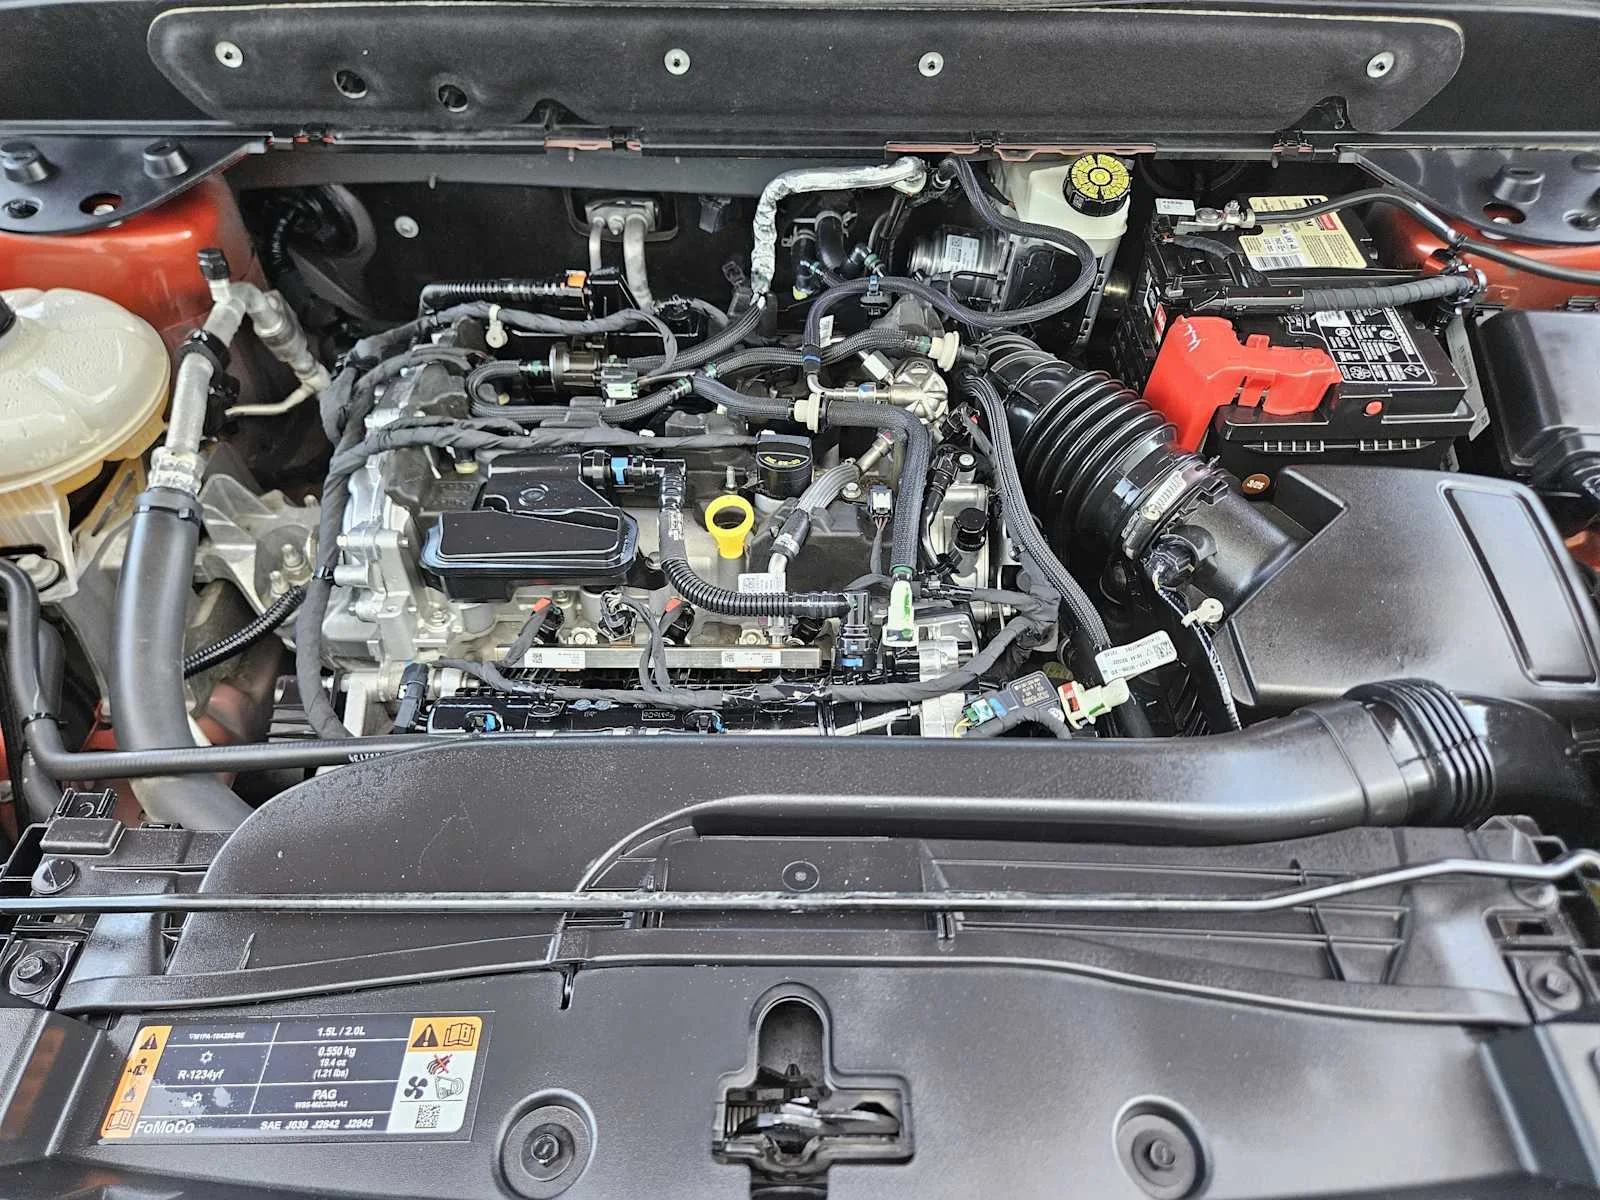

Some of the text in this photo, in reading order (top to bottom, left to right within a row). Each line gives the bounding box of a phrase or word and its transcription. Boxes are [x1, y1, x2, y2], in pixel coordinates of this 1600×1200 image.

[317, 1026, 337, 1036] 1.5L
[344, 1026, 366, 1036] 2.0L
[318, 1045, 357, 1058] 0.550 kg
[336, 1059, 347, 1067] oz
[177, 1069, 225, 1081] R-1234yf
[313, 1067, 349, 1080] (1.21 lbs)
[312, 1089, 337, 1100] PAG
[134, 1120, 195, 1134] FoMoCo
[260, 1118, 374, 1130] SAE J639 J2842 J2845
